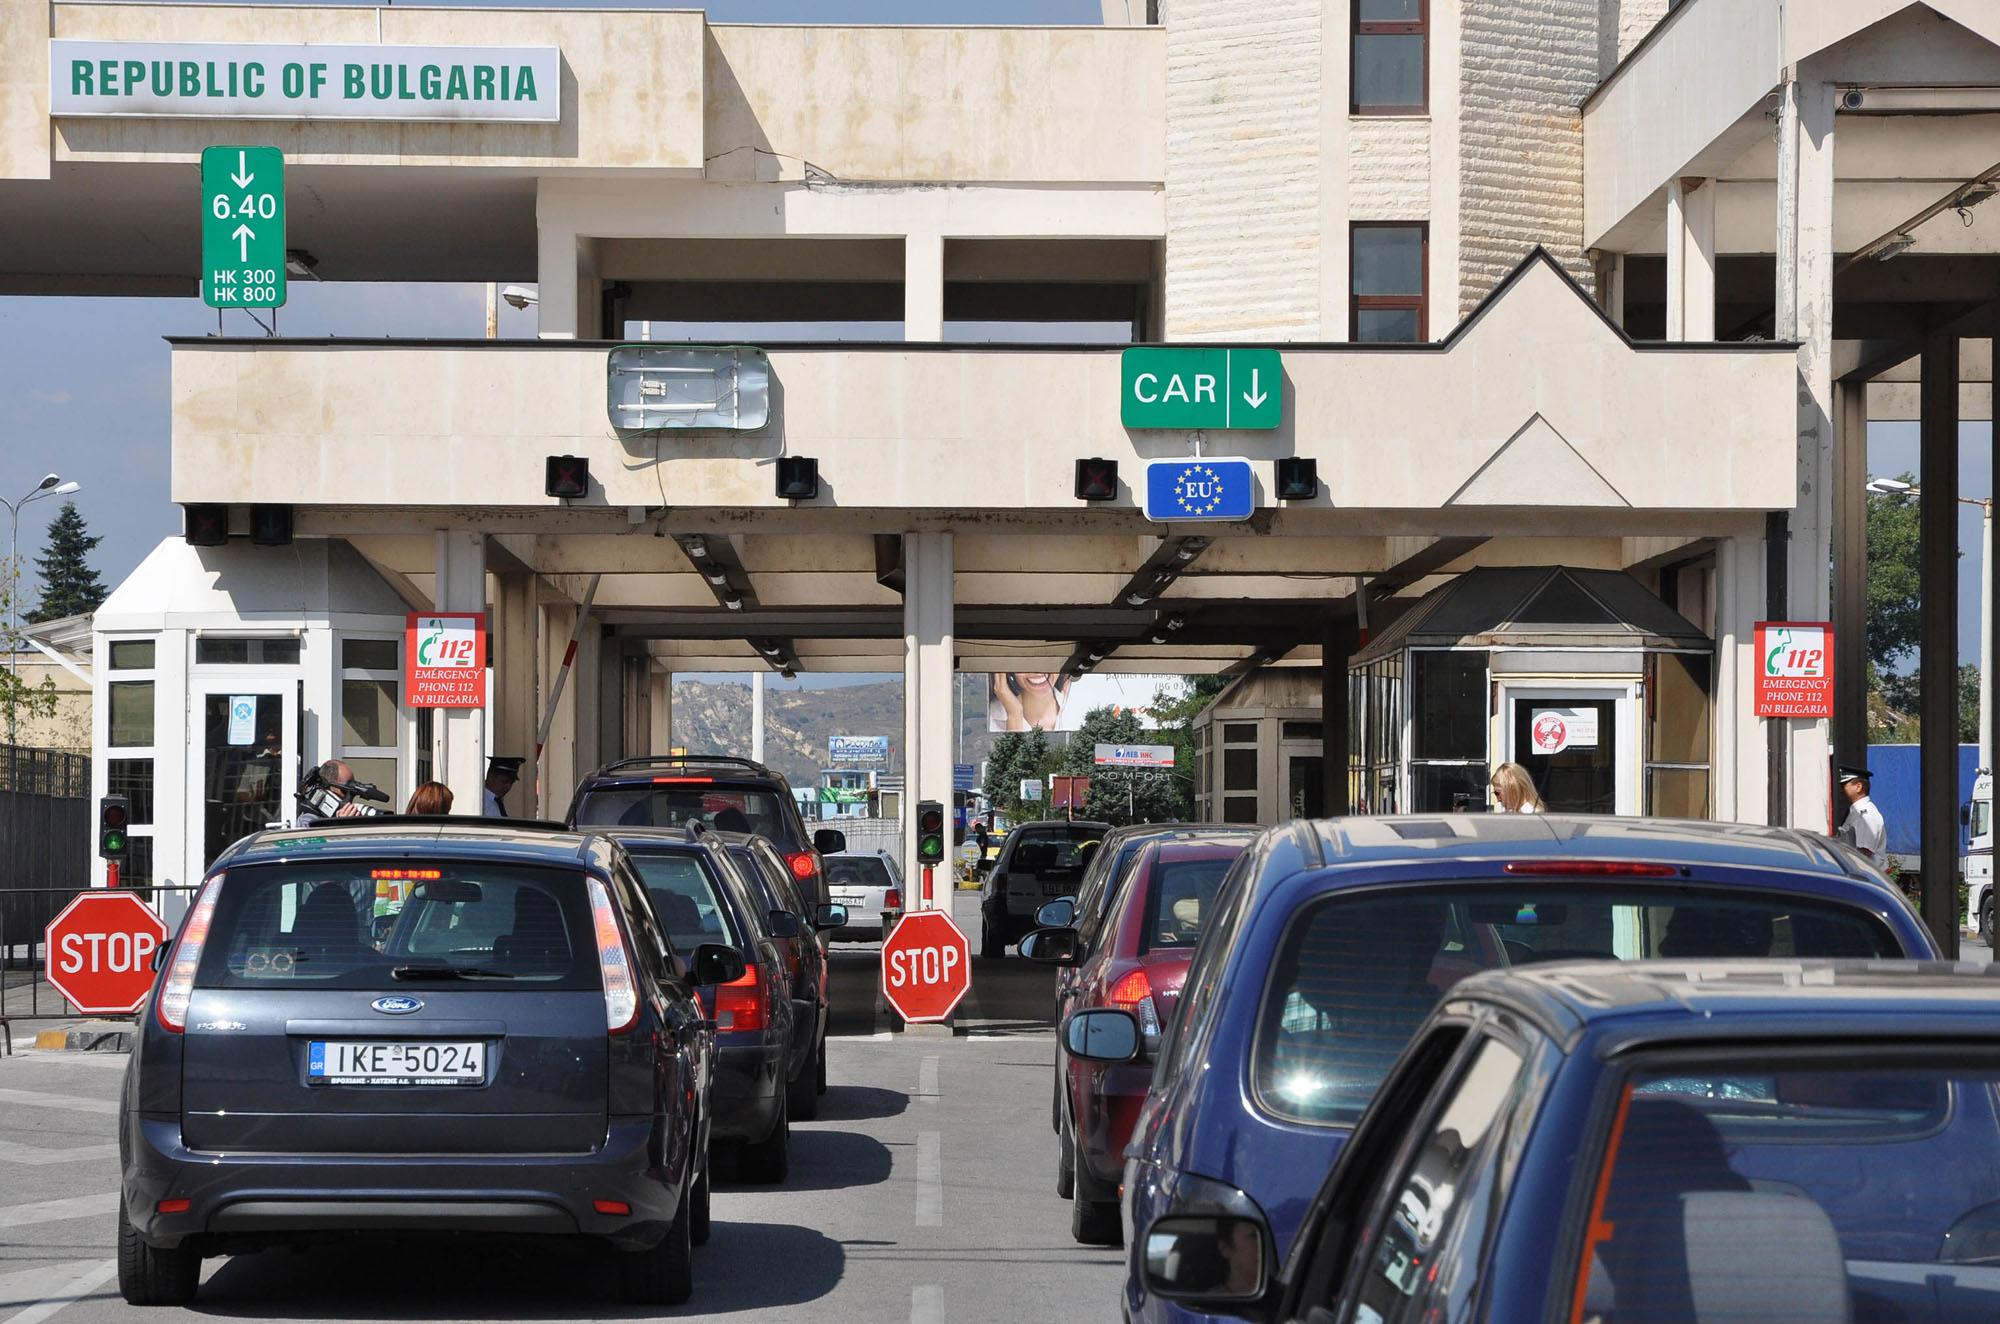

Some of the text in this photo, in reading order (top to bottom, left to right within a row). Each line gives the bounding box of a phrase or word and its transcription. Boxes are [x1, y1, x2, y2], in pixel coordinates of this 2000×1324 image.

[71, 59, 538, 101] REPUBLIC OF BULGARIA
[212, 193, 276, 220] 6.40
[213, 269, 276, 285] HK 300
[213, 286, 276, 302] HK 800
[1134, 372, 1216, 403] CAR
[1185, 482, 1213, 498] EU
[439, 640, 474, 659] 112
[1787, 649, 1823, 668] 112
[414, 670, 480, 680] EMERGENCY
[418, 682, 474, 692] PHONE 112
[1763, 679, 1829, 690] EMERGENCY
[411, 694, 480, 704] IN BULGARIA
[1766, 691, 1823, 702] PHONE 112
[1760, 703, 1828, 714] IN BULGARIA
[60, 932, 156, 974] STOP
[890, 945, 959, 987] STOP
[196, 1021, 247, 1031] FOUS
[310, 1061, 324, 1071] GR
[339, 1046, 477, 1073] IKE-5024
